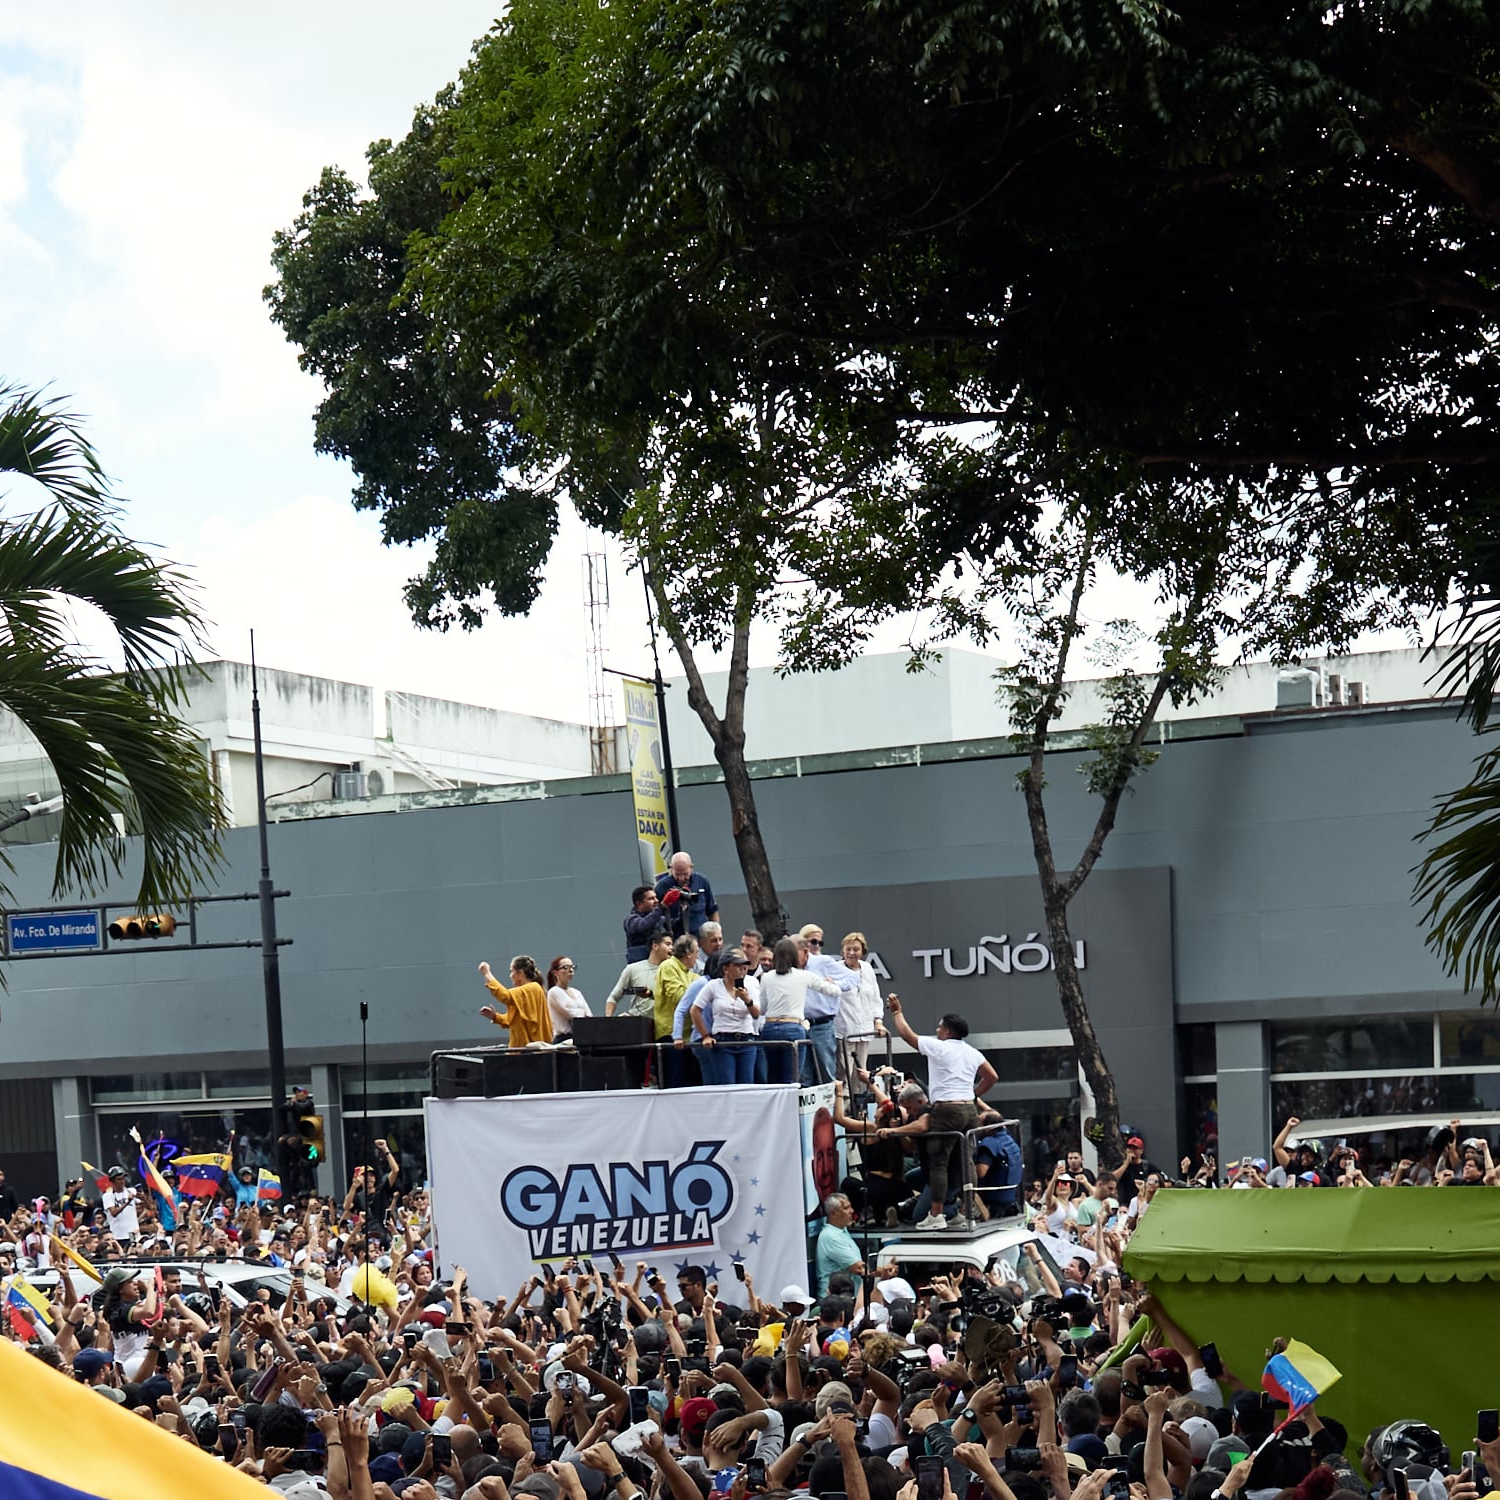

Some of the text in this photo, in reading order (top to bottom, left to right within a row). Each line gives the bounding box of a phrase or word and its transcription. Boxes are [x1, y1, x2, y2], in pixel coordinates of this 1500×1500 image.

[656, 811, 665, 820] EN
[639, 820, 667, 837] DAKA
[13, 923, 96, 938] Av. Fco. De Miranda
[502, 1142, 732, 1229] GANÓ
[531, 1210, 711, 1257] VENEZUELA
